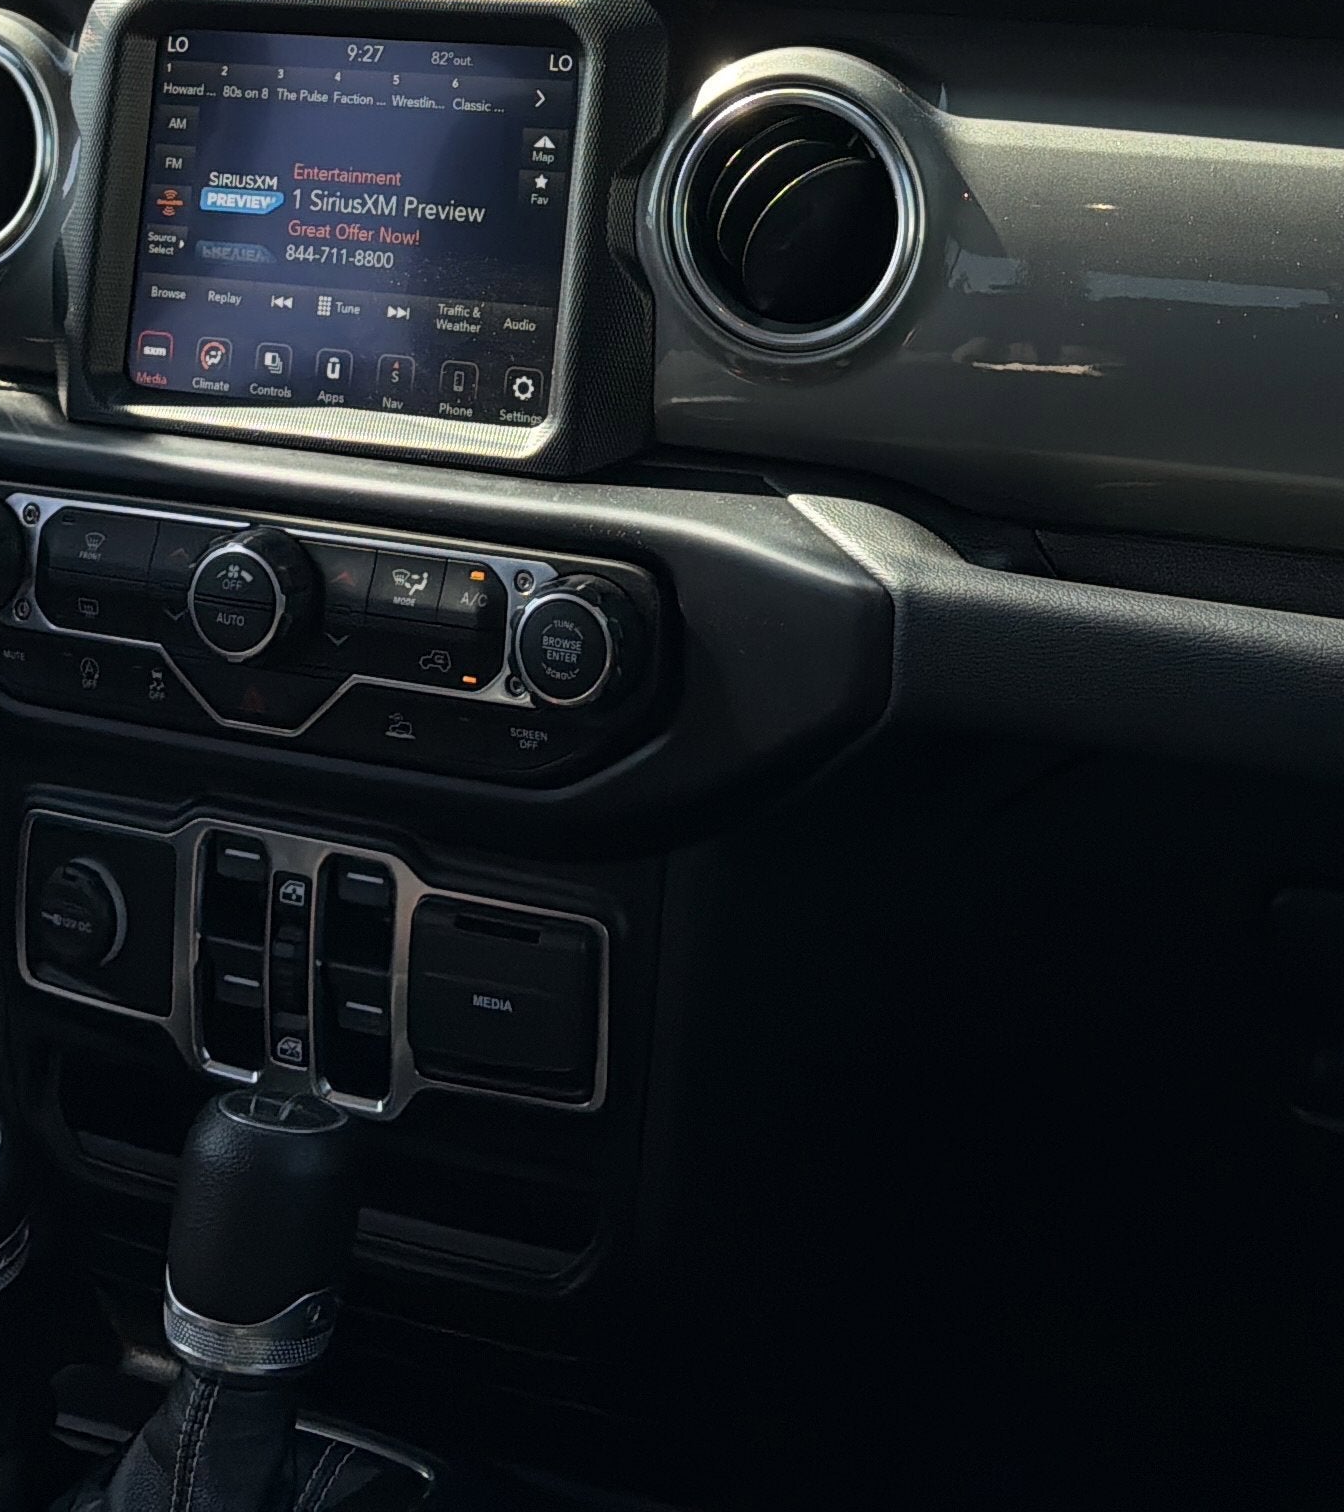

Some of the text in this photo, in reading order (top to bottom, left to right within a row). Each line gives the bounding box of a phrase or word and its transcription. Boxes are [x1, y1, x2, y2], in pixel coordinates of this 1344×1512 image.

[167, 36, 189, 53] LO
[347, 44, 385, 63] 9:27
[166, 62, 172, 73] 1
[549, 54, 573, 72] LO
[221, 65, 229, 76] 2
[277, 68, 285, 79] 3
[334, 71, 342, 82] 4
[392, 74, 400, 85] 5
[452, 78, 460, 89] 6
[222, 85, 269, 100] 80s on 8
[277, 88, 329, 103] The Pulse
[168, 117, 187, 129] AM
[164, 157, 183, 170] FM
[531, 151, 554, 165] Map
[209, 171, 278, 190] SIRIUSXM
[294, 163, 402, 186] Entertainment
[207, 192, 277, 210] PREVIEW
[292, 189, 486, 223] 1 SiriusXM Preview
[531, 194, 549, 205] Fav
[147, 231, 177, 243] Source
[288, 220, 420, 246] Great Offer Now!
[148, 244, 175, 256] Select
[286, 244, 394, 269] 844-711-8800
[151, 286, 186, 300] Browse
[207, 290, 243, 306] Replay
[335, 301, 361, 315] Tune
[438, 303, 482, 319] Traffic &
[436, 318, 482, 333] Weather
[503, 317, 536, 331] Audio
[136, 371, 167, 386] Media
[192, 376, 230, 392] Climate
[249, 382, 292, 399] Controls
[317, 390, 345, 404] Apps
[382, 396, 404, 410] Nav
[439, 402, 473, 418] Phone
[499, 409, 544, 425] Settings
[222, 579, 243, 590] OFF
[392, 595, 416, 606] MODE
[460, 591, 488, 607] A/C
[216, 612, 245, 626] AUTO
[553, 619, 575, 632] TUNE
[542, 635, 583, 651] BROWSE
[2, 649, 26, 661] MUTE
[546, 649, 578, 664] ENTER
[545, 667, 578, 680] SCROLL
[510, 727, 548, 742] SCREEN
[519, 740, 539, 751] OFF
[472, 993, 513, 1013] MEDIA
